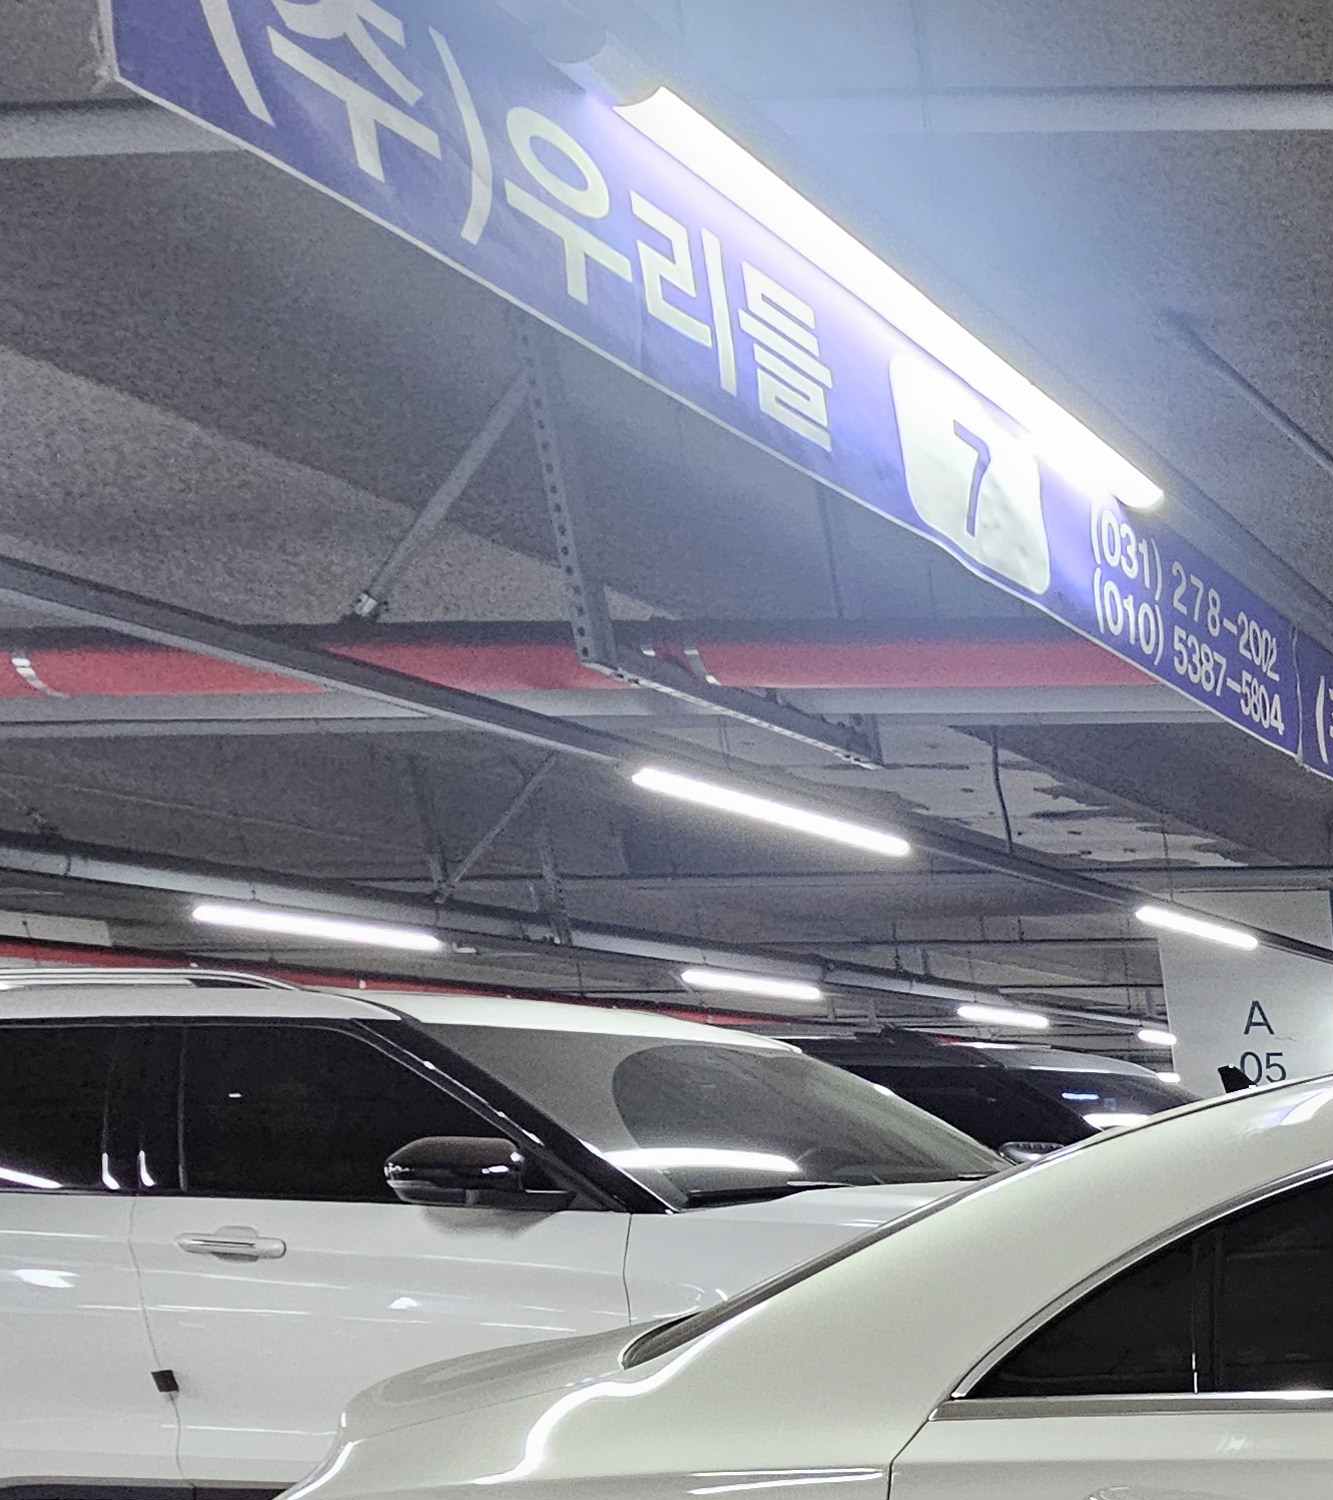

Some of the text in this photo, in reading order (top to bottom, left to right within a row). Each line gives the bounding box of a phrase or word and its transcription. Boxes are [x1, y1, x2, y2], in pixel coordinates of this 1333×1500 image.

[952, 419, 992, 538] 7
[1091, 495, 1281, 683] (031) 278-2002
[1093, 566, 1285, 736] (010) 5387-5804
[1239, 1051, 1287, 1083] 05
[1243, 1000, 1275, 1035] A
